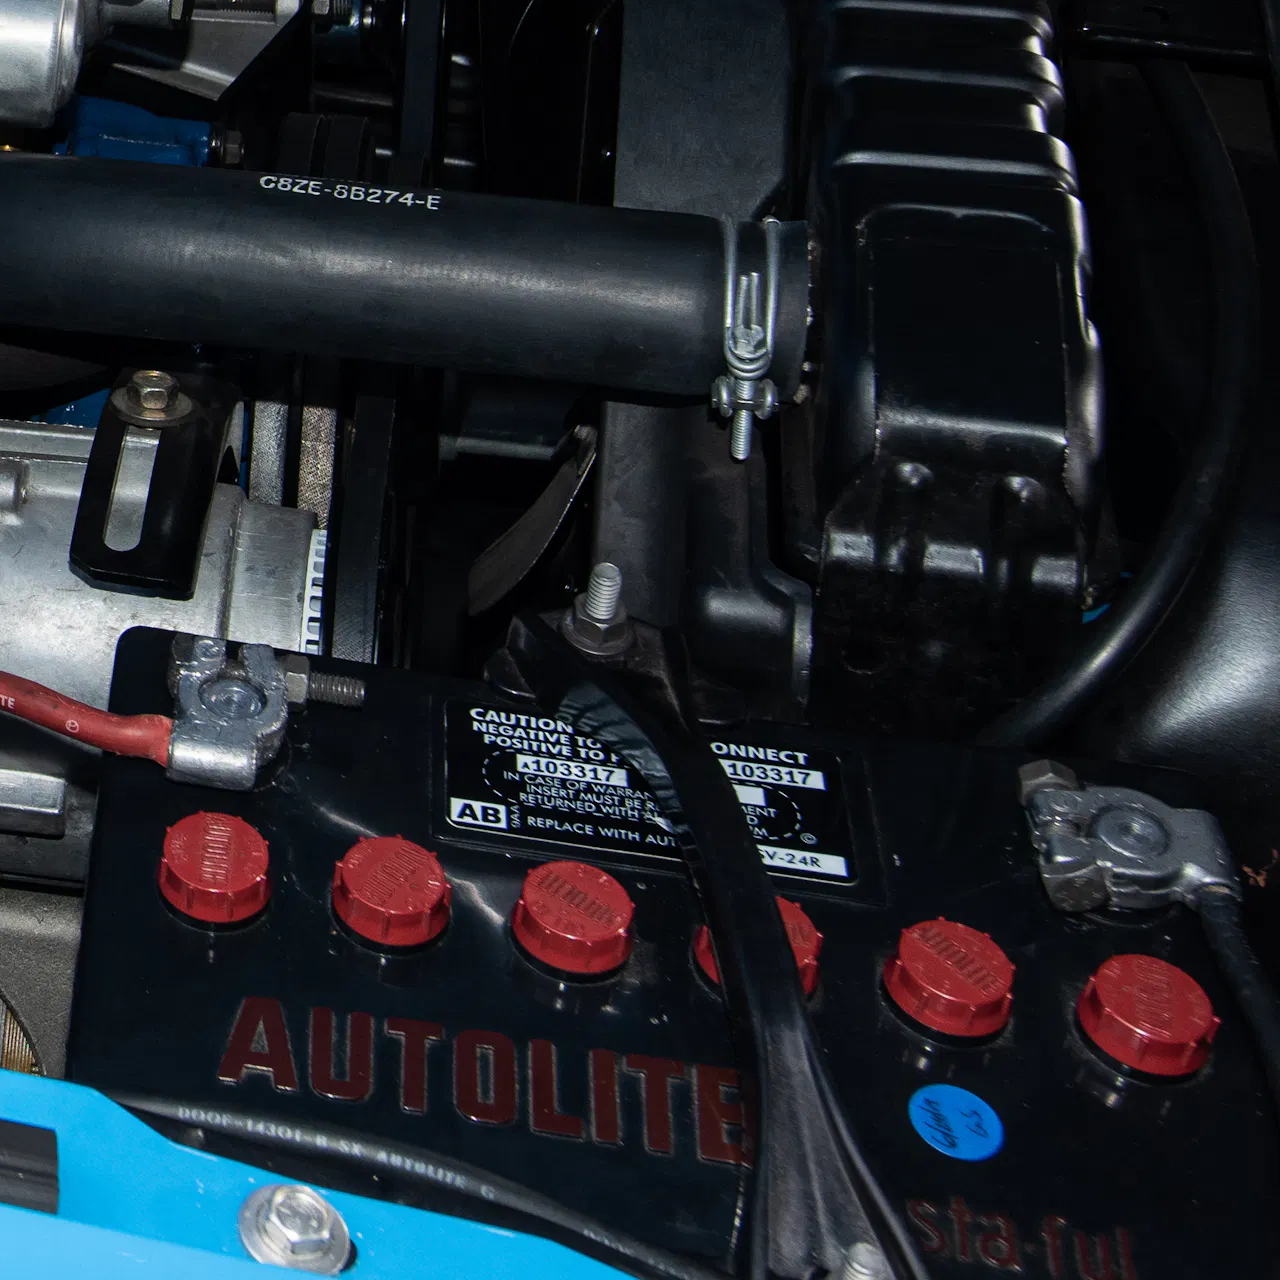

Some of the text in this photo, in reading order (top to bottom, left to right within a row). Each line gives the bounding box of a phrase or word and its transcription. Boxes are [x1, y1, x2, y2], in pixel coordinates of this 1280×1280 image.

[469, 708, 574, 734] CAUTION
[472, 721, 602, 749] NEGATIVE TO
[483, 734, 572, 757] POSITIVE
[576, 746, 605, 761] TO
[711, 742, 808, 765] ONNECT
[504, 770, 519, 781] IN
[525, 773, 565, 788] CASE
[567, 780, 588, 791] OF
[519, 792, 596, 812] RETURNED
[600, 803, 639, 819] WITH
[526, 783, 576, 799] INSERT
[579, 792, 620, 806] MUST
[624, 798, 642, 809] BE
[457, 802, 502, 824] AB
[527, 816, 594, 836] REPLACE
[598, 826, 640, 842] WITH
[217, 996, 752, 1167] AUTOLITE
[375, 1151, 467, 1189] AUTOLITE
